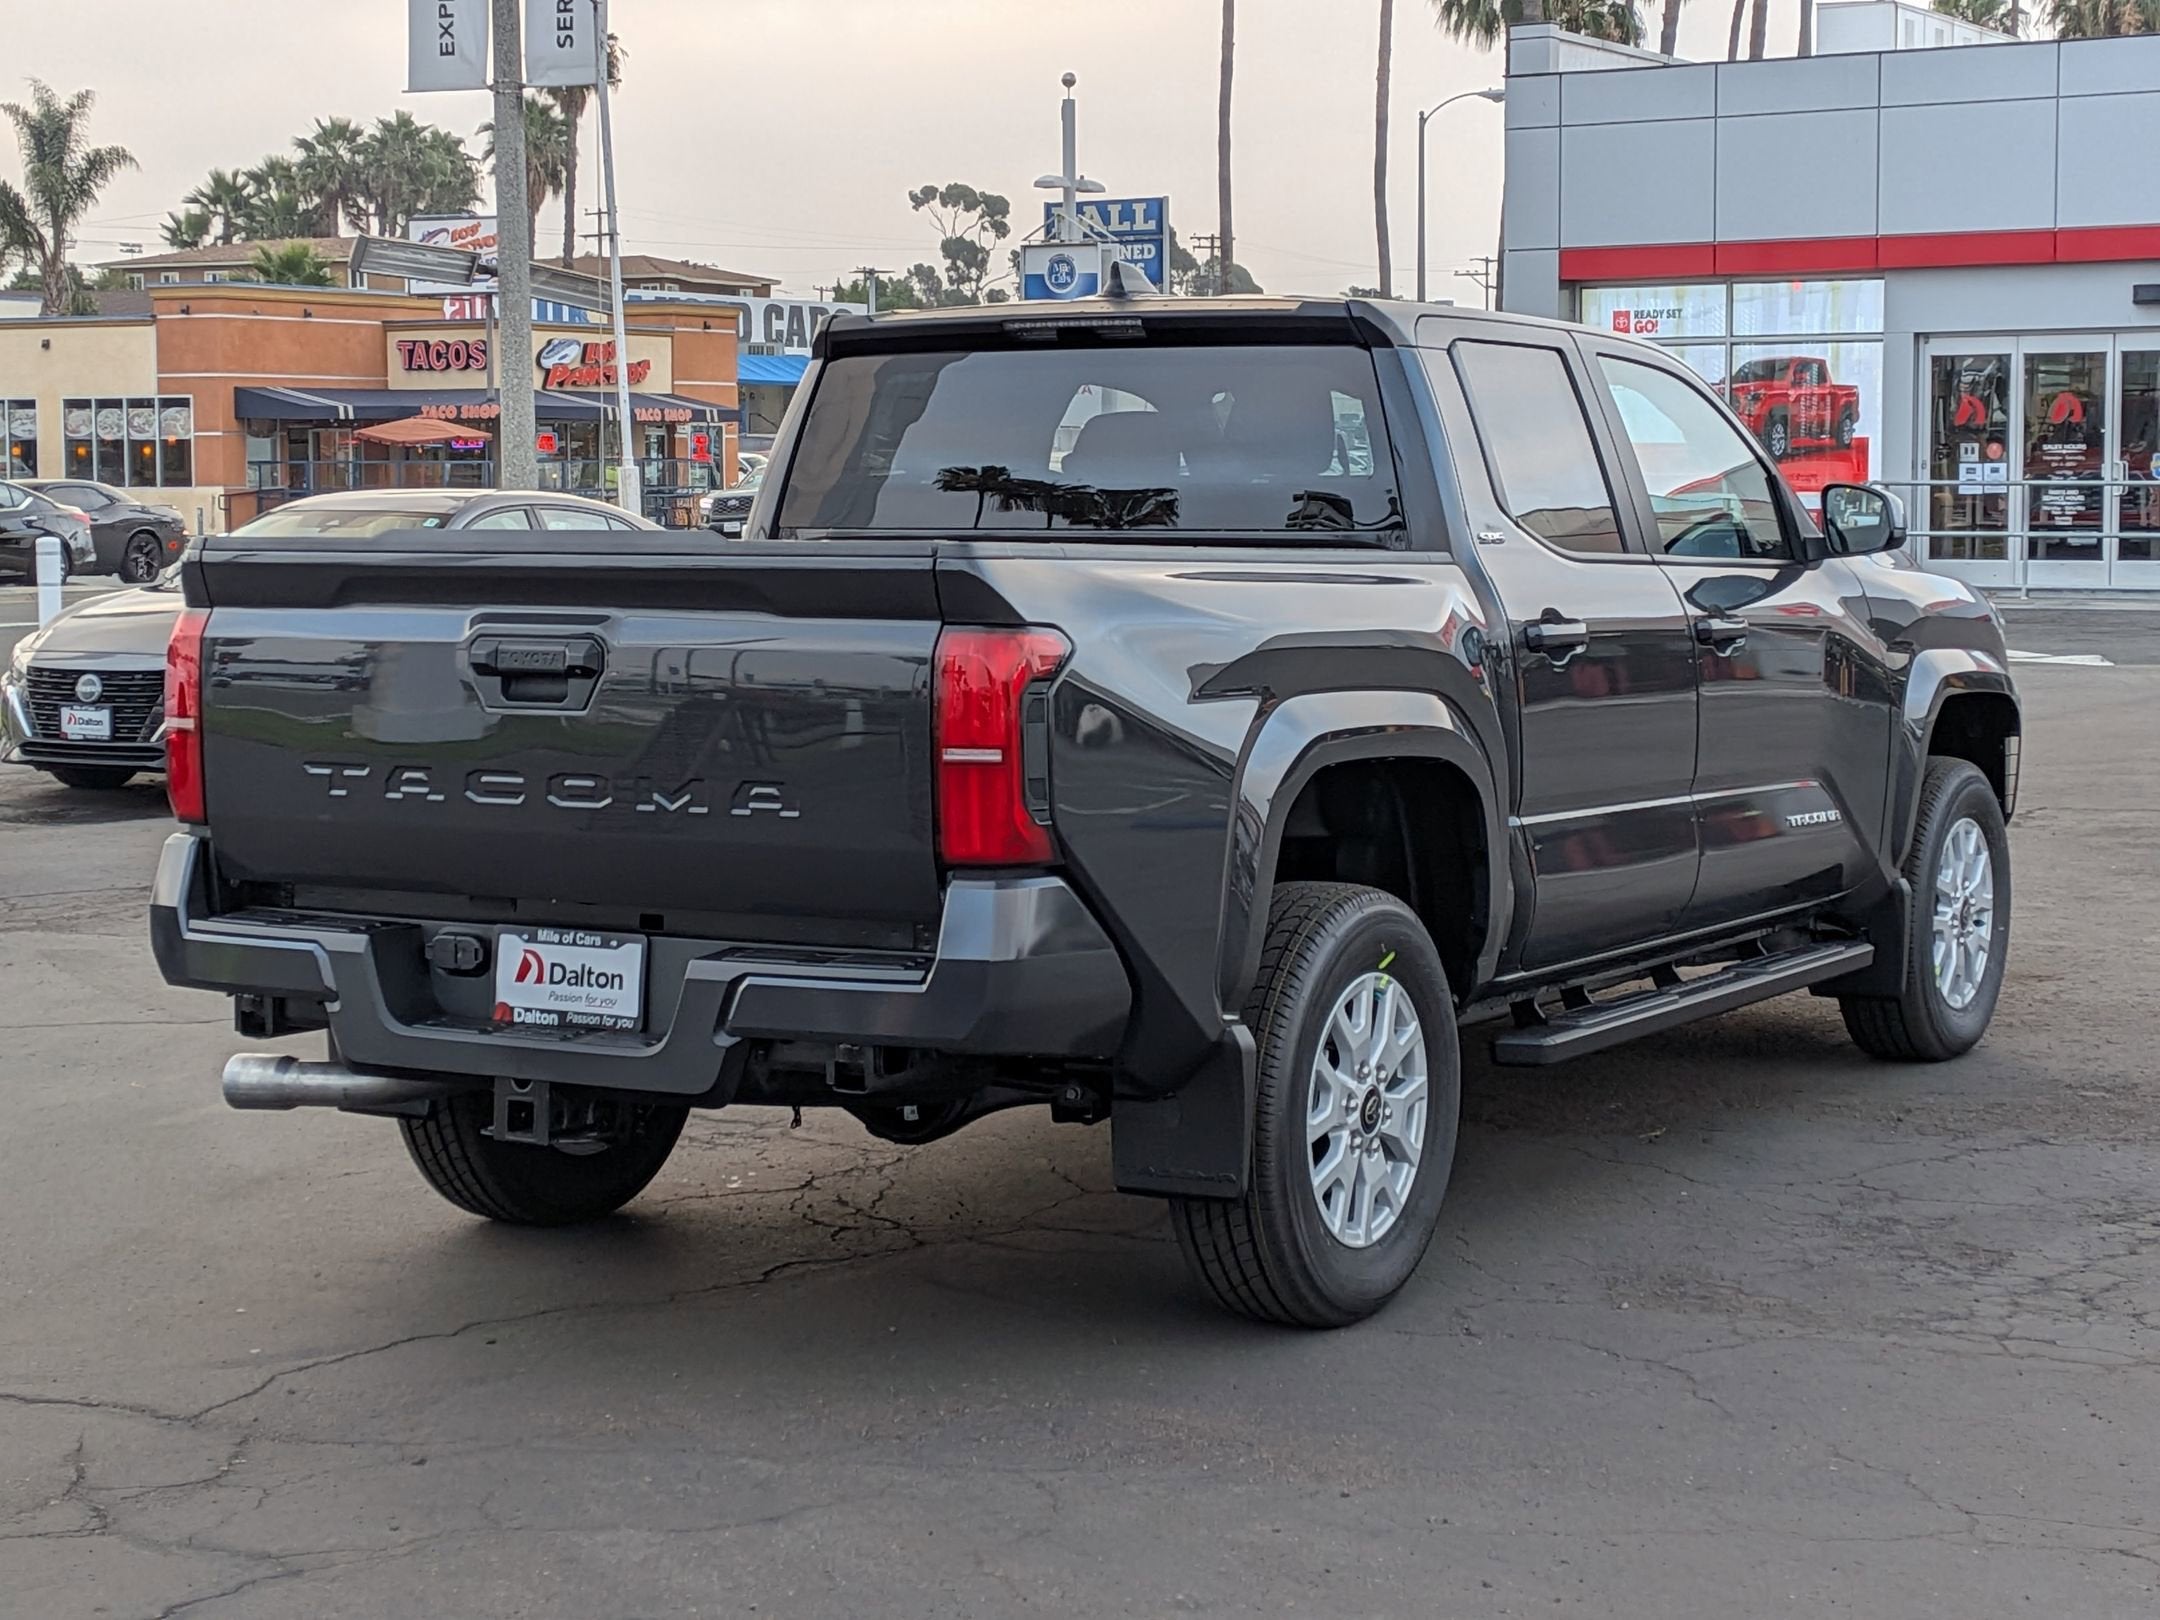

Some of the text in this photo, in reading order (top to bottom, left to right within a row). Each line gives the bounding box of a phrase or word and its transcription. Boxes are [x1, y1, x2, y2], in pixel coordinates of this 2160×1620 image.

[438, 0, 457, 57] EXP
[1052, 203, 1157, 243] ALL
[1634, 308, 1683, 320] READY SET
[1634, 319, 1658, 334] GO!
[396, 340, 488, 371] TACOS
[421, 404, 501, 419] TACO SHOP
[634, 408, 693, 422] TACO SHOP
[501, 651, 560, 665] TOYOTA
[78, 717, 103, 726] Dalton
[303, 760, 800, 818] TACOMA
[537, 929, 601, 946] Mile of Cars
[549, 962, 623, 990] Dalton
[548, 991, 618, 1008] Passion for you
[513, 1008, 634, 1029] Dalton Passion for you
